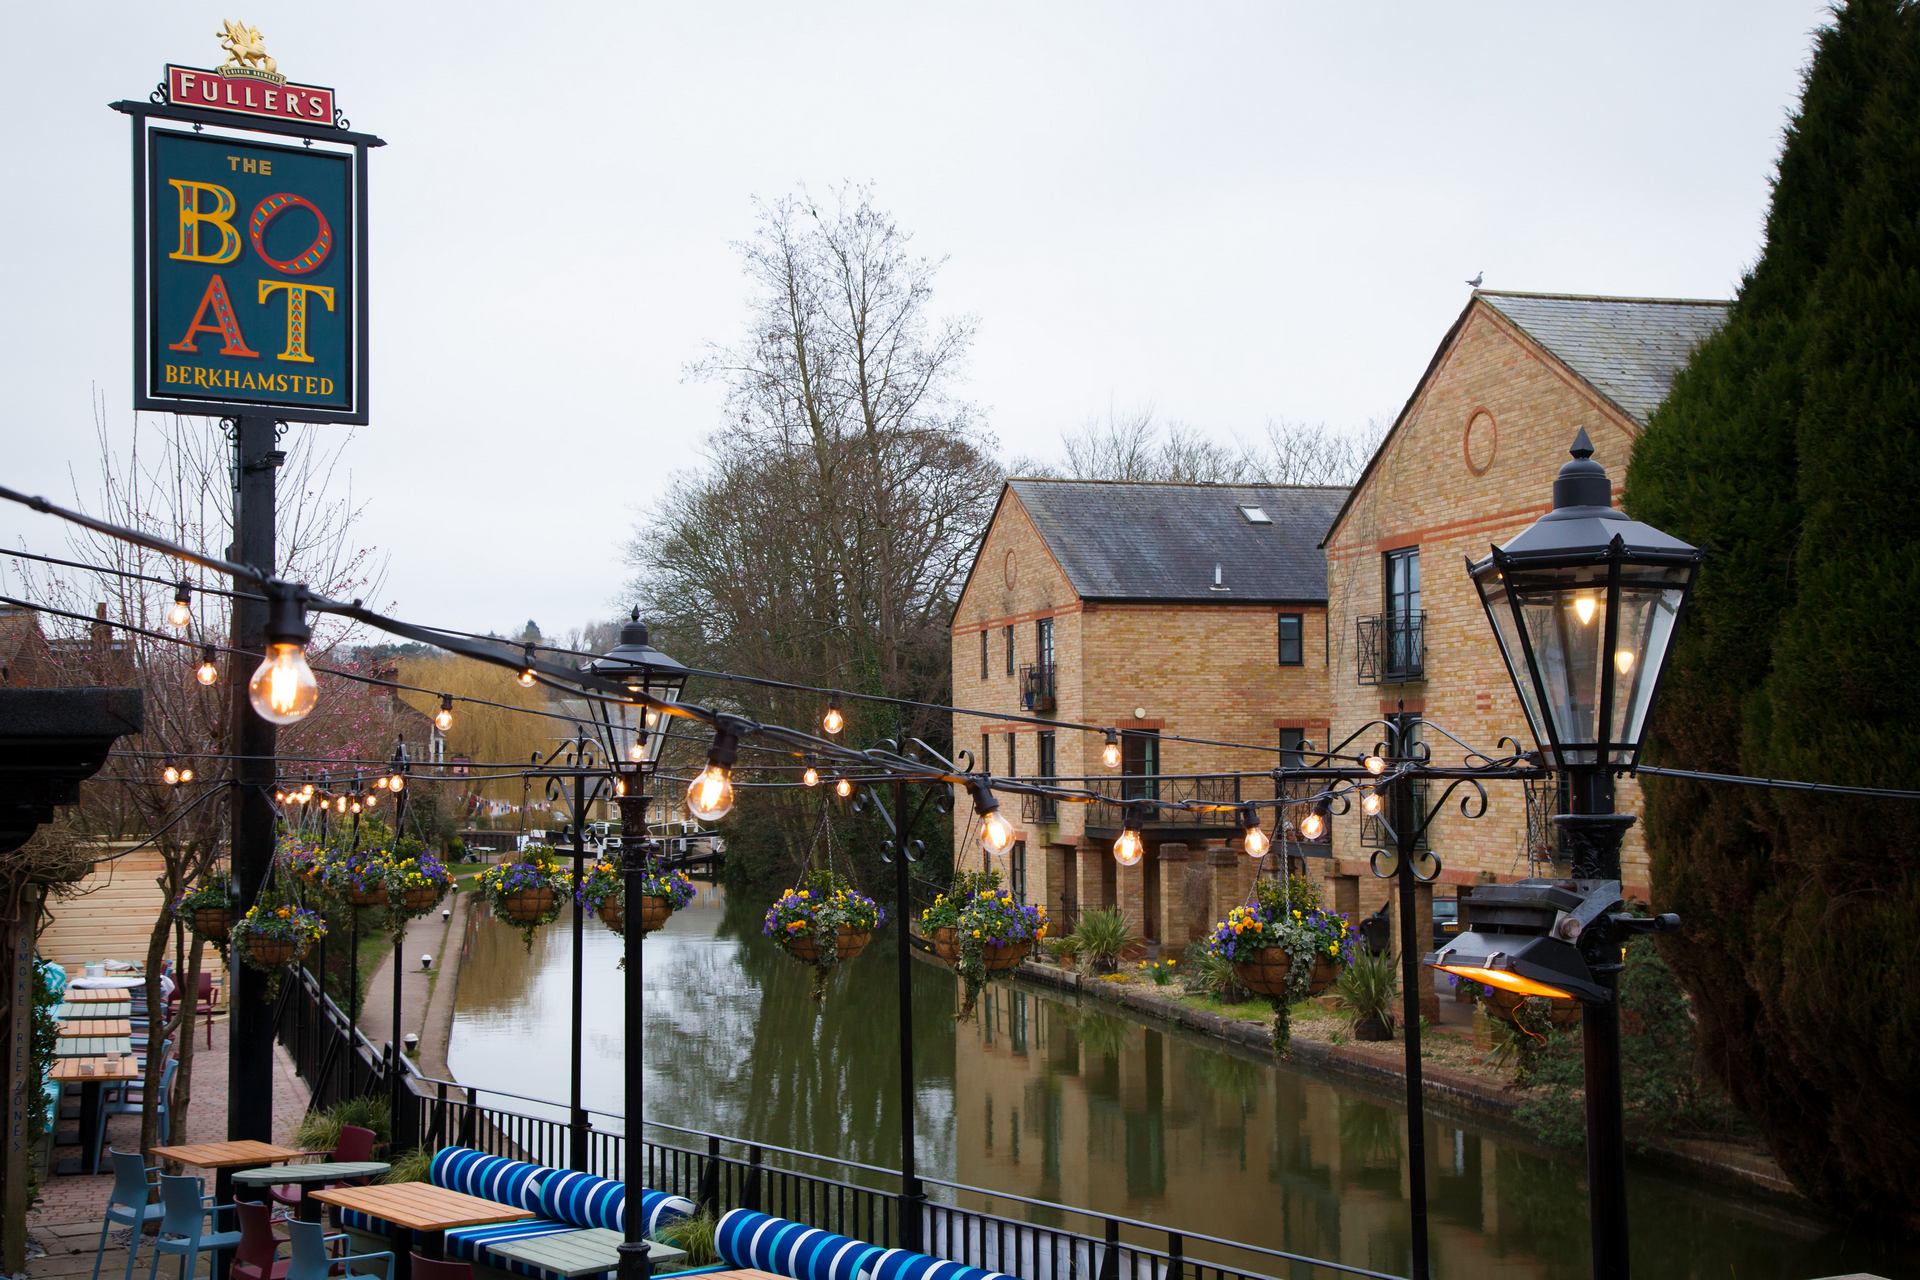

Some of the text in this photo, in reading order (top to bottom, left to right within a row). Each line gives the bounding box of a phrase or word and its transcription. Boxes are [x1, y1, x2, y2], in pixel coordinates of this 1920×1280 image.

[180, 72, 324, 117] FULLER'S
[227, 156, 272, 176] THE
[165, 364, 334, 396] BERKHAMSTED
[17, 937, 28, 1007] SMOKE
[16, 1017, 24, 1072] FREE
